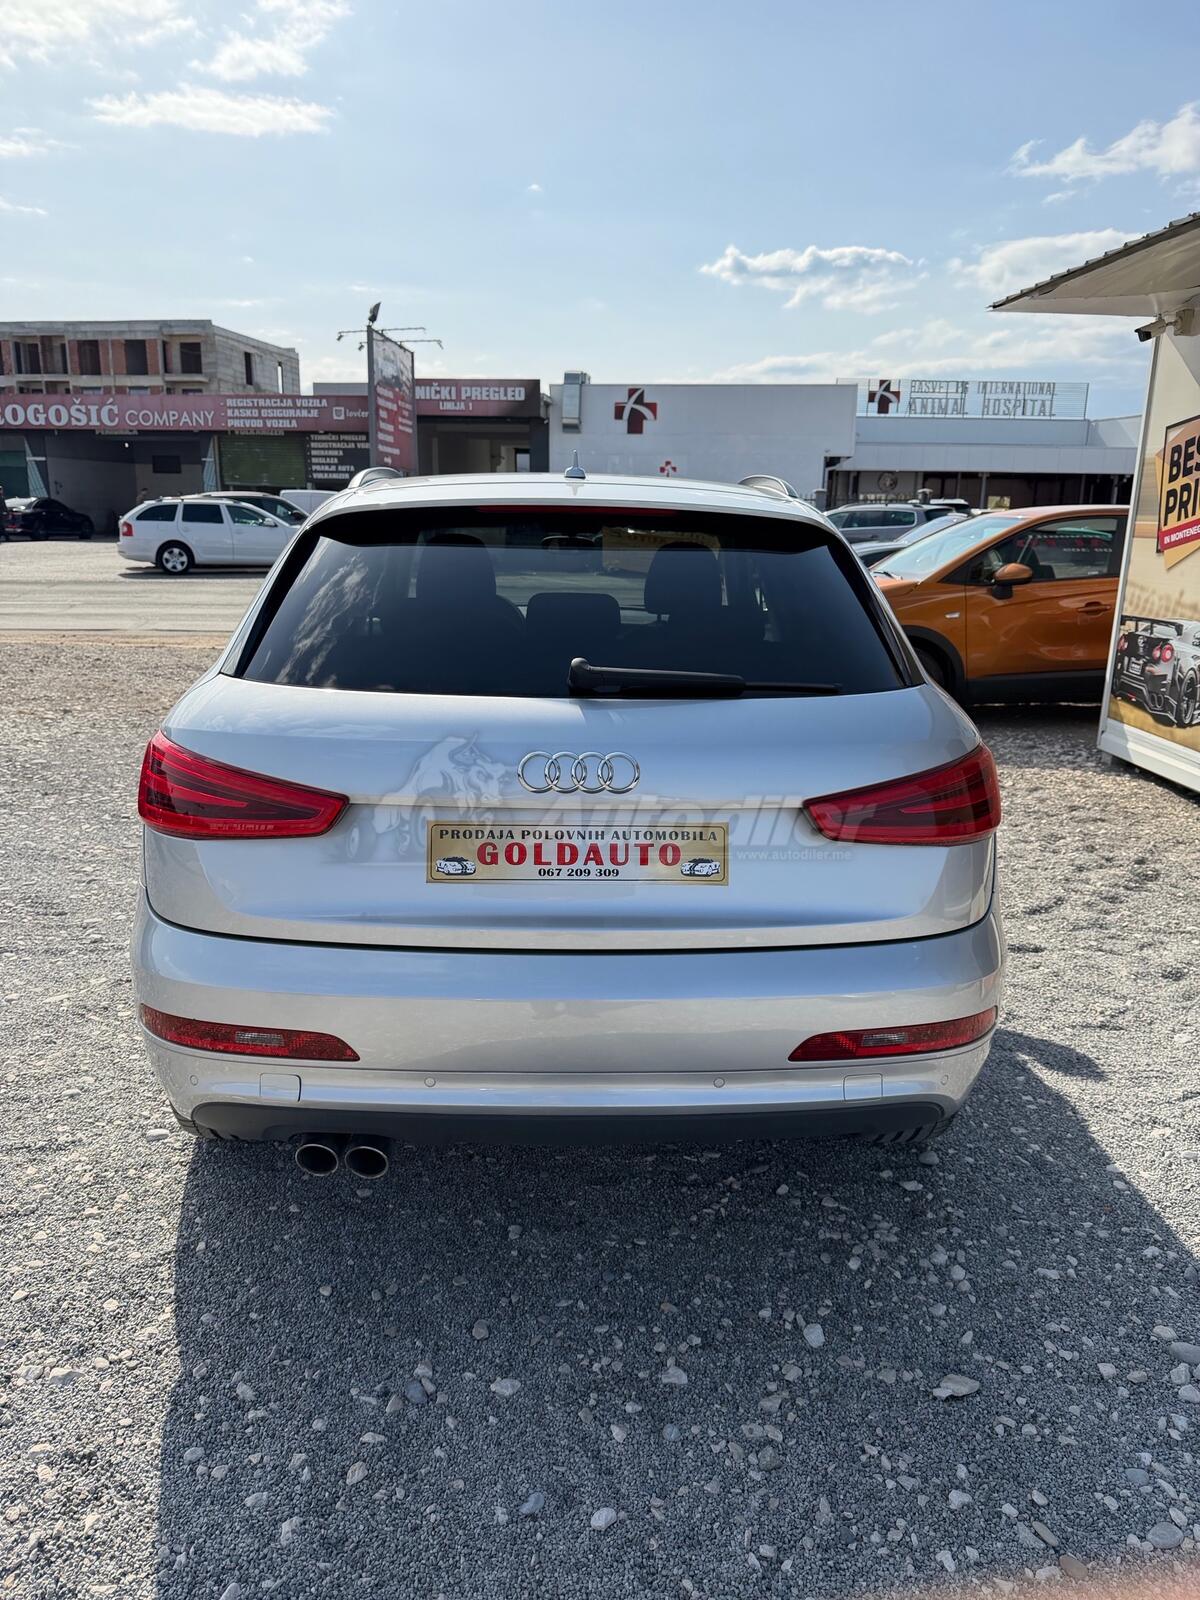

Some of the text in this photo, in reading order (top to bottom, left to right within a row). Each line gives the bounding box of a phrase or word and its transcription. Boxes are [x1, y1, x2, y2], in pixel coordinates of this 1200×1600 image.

[461, 386, 526, 401] PREGLED
[977, 381, 1058, 395] INTERNATIONAL
[226, 398, 328, 407] REGISTRACIJA VOZILA
[440, 401, 466, 411] LINIJA
[908, 398, 1057, 416] ANIMAL HOSPITAL
[125, 409, 214, 427] COMPANY
[227, 408, 319, 418] KASKO OSIGURANJE
[227, 418, 298, 428] PREVOD VOZILA
[1163, 478, 1200, 526] PRI
[1164, 535, 1171, 544] IN
[439, 829, 718, 842] PRODAJA POLOVNIH AUTOMOBILA
[476, 841, 682, 867] GOLDAUTO
[538, 867, 620, 878] 067 209 309
